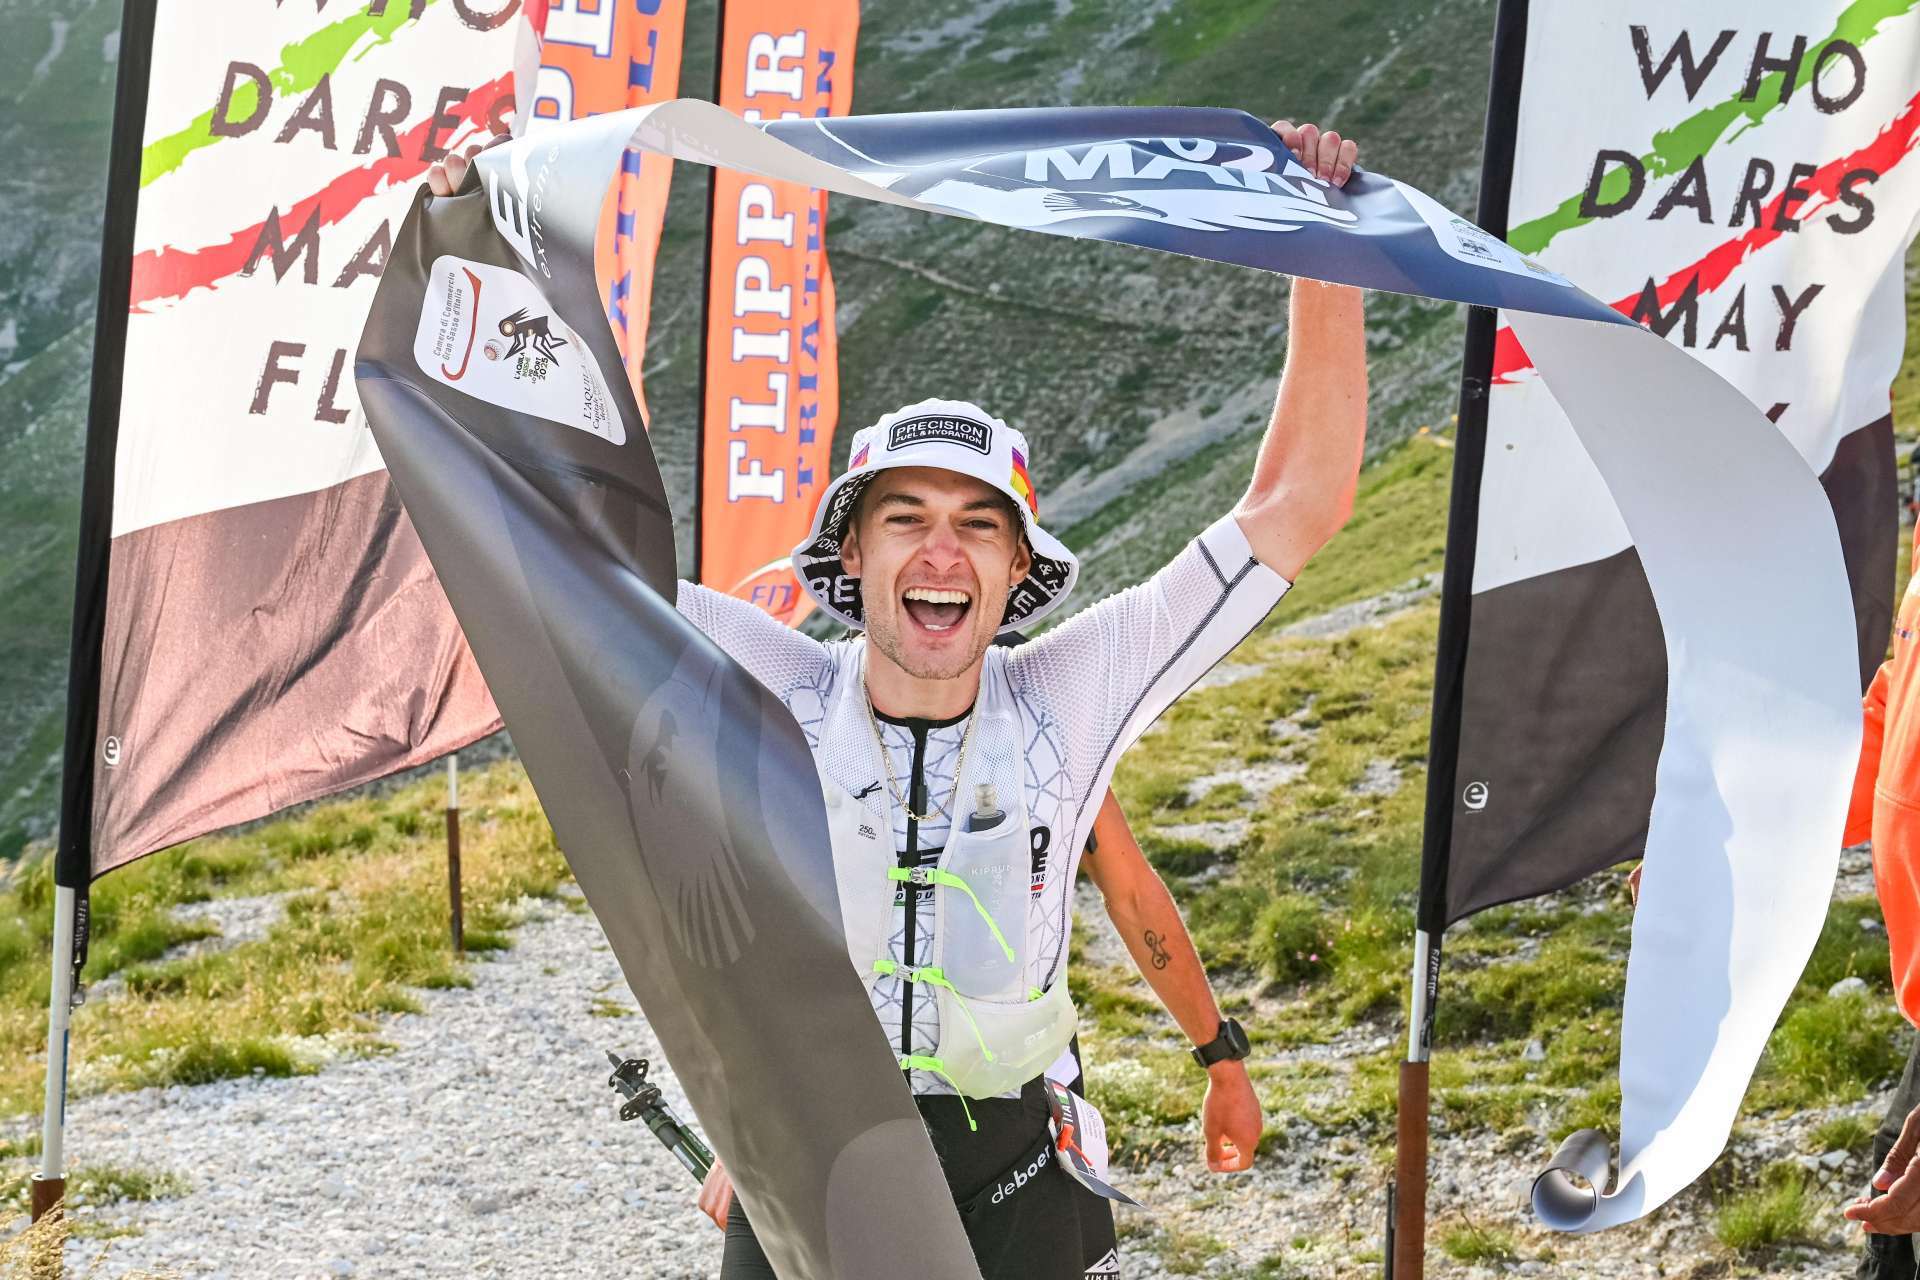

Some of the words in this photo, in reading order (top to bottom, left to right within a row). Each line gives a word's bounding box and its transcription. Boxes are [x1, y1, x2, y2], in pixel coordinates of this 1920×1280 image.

[1629, 24, 1867, 115] WHO
[1578, 149, 1880, 235] DARES
[238, 202, 394, 289] MA
[728, 29, 807, 503] FLIPPR
[442, 272, 456, 318] Commercio
[797, 48, 836, 498] TRIATHN
[440, 318, 449, 327] di
[447, 317, 460, 342] Sasso
[1631, 274, 1825, 352] MAY
[433, 328, 446, 357] Camera
[442, 343, 454, 361] Gran
[538, 357, 549, 381] 2025
[249, 340, 353, 424] FL
[895, 432, 918, 444] FUEL
[927, 429, 982, 445] HYDRATION
[896, 420, 983, 439] PRECISION
[991, 1144, 1050, 1204] deboer
